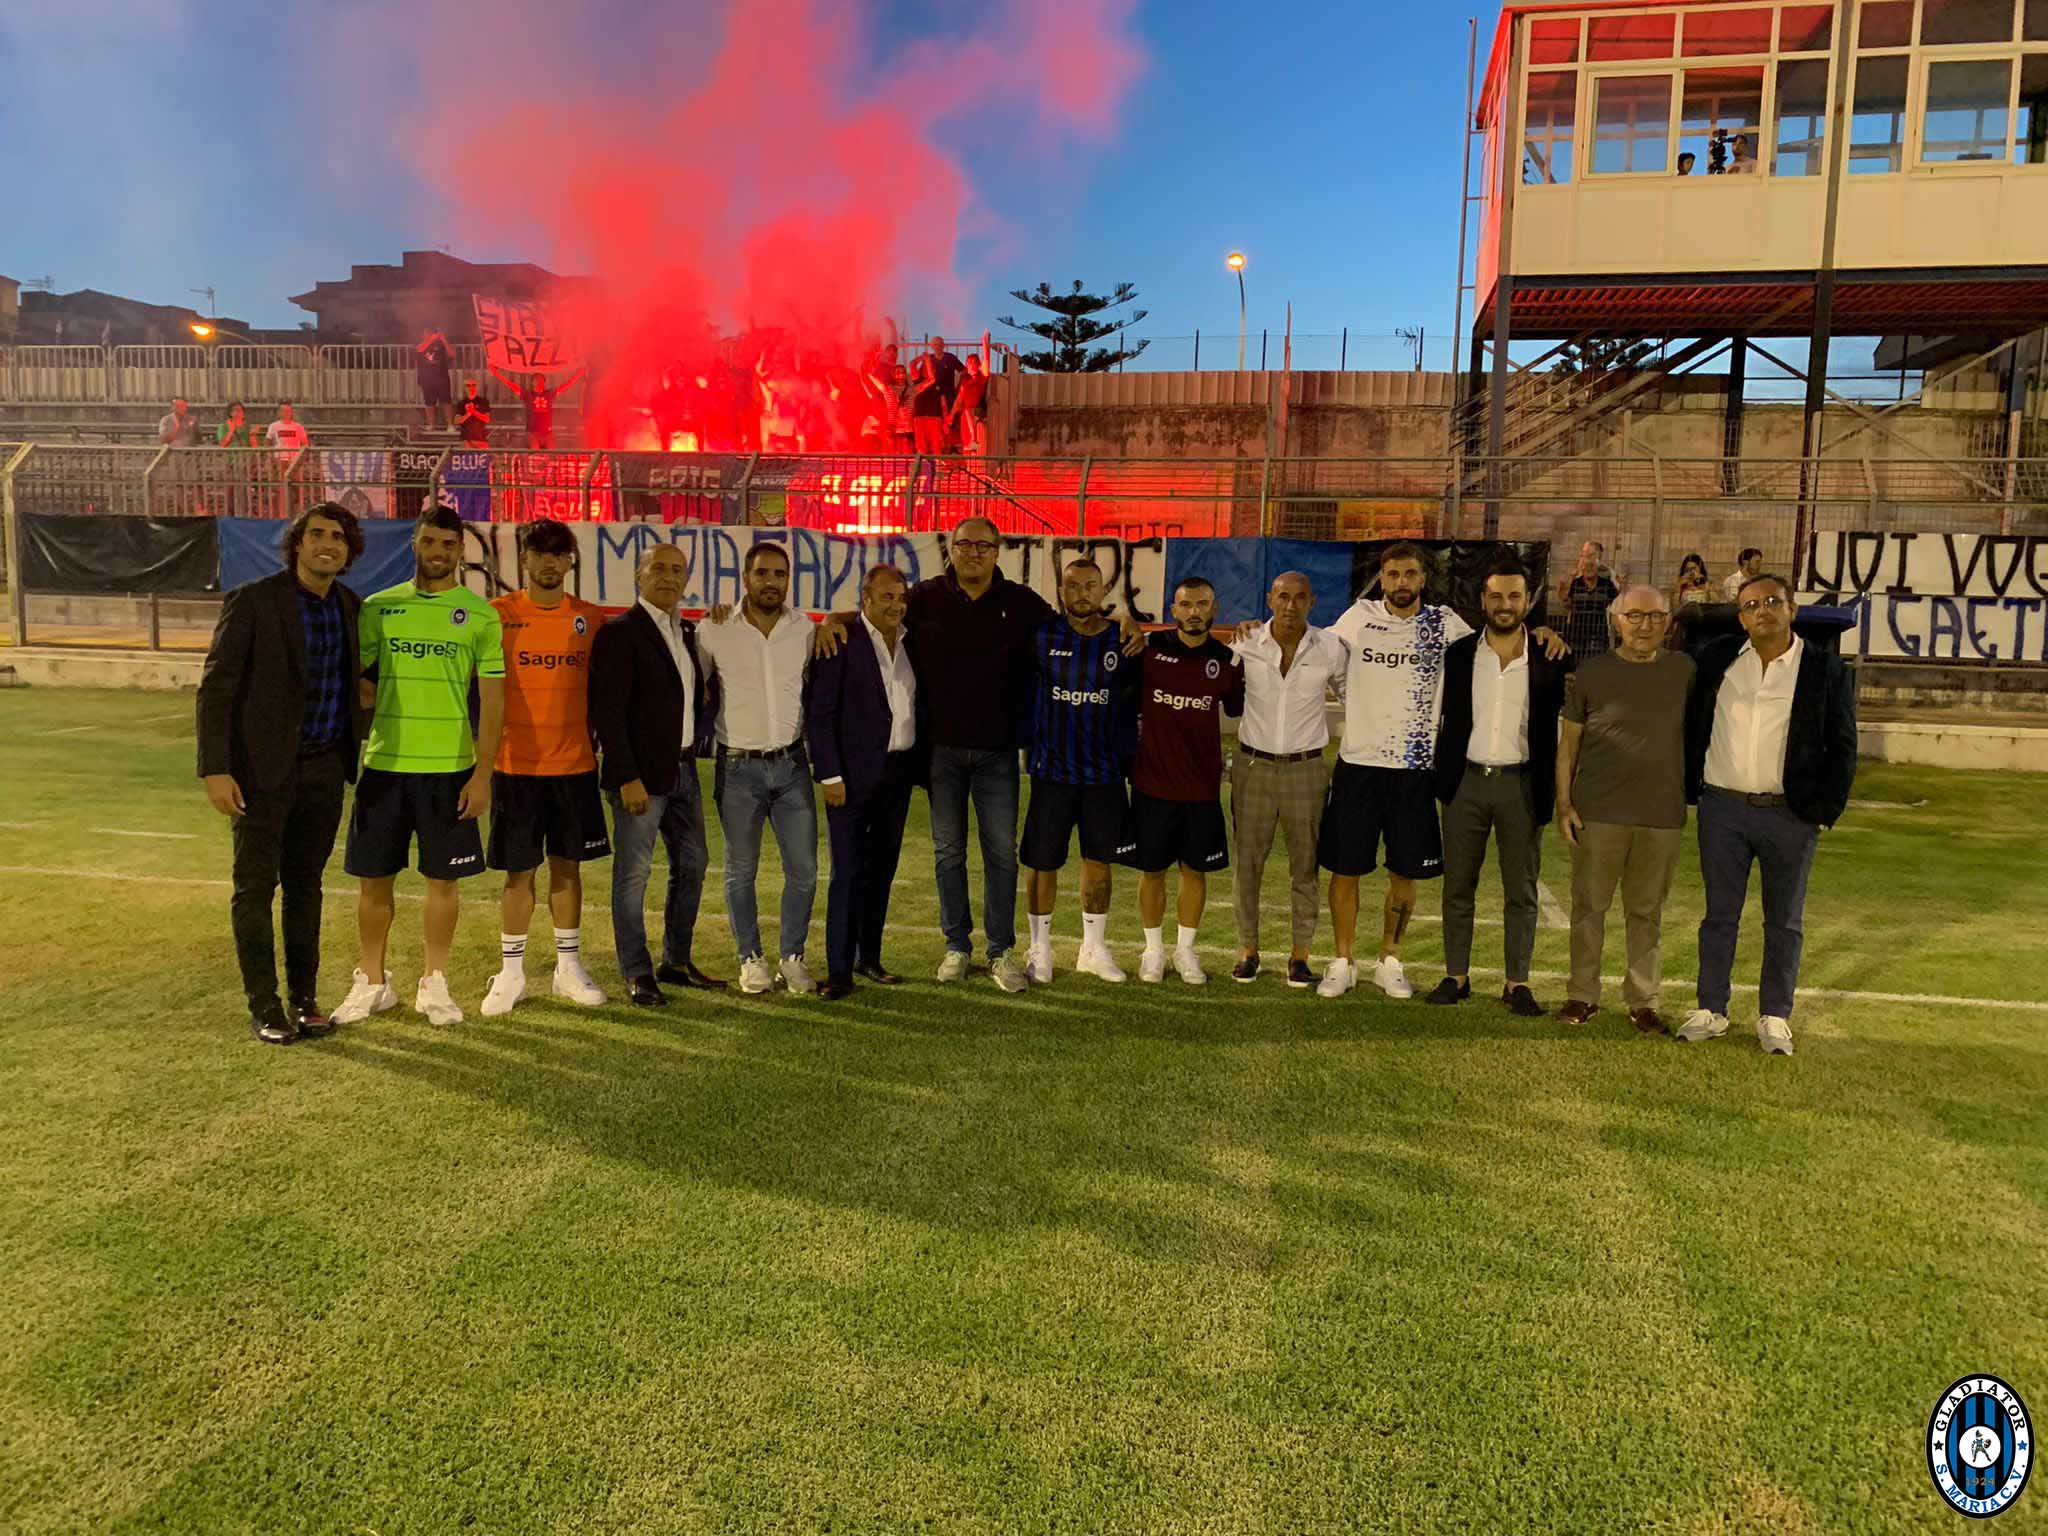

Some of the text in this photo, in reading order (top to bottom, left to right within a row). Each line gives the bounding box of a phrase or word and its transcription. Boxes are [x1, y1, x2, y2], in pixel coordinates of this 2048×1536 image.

[452, 453, 488, 471] BLUE
[1806, 531, 1918, 593] NOI
[1887, 595, 2048, 661] GAET
